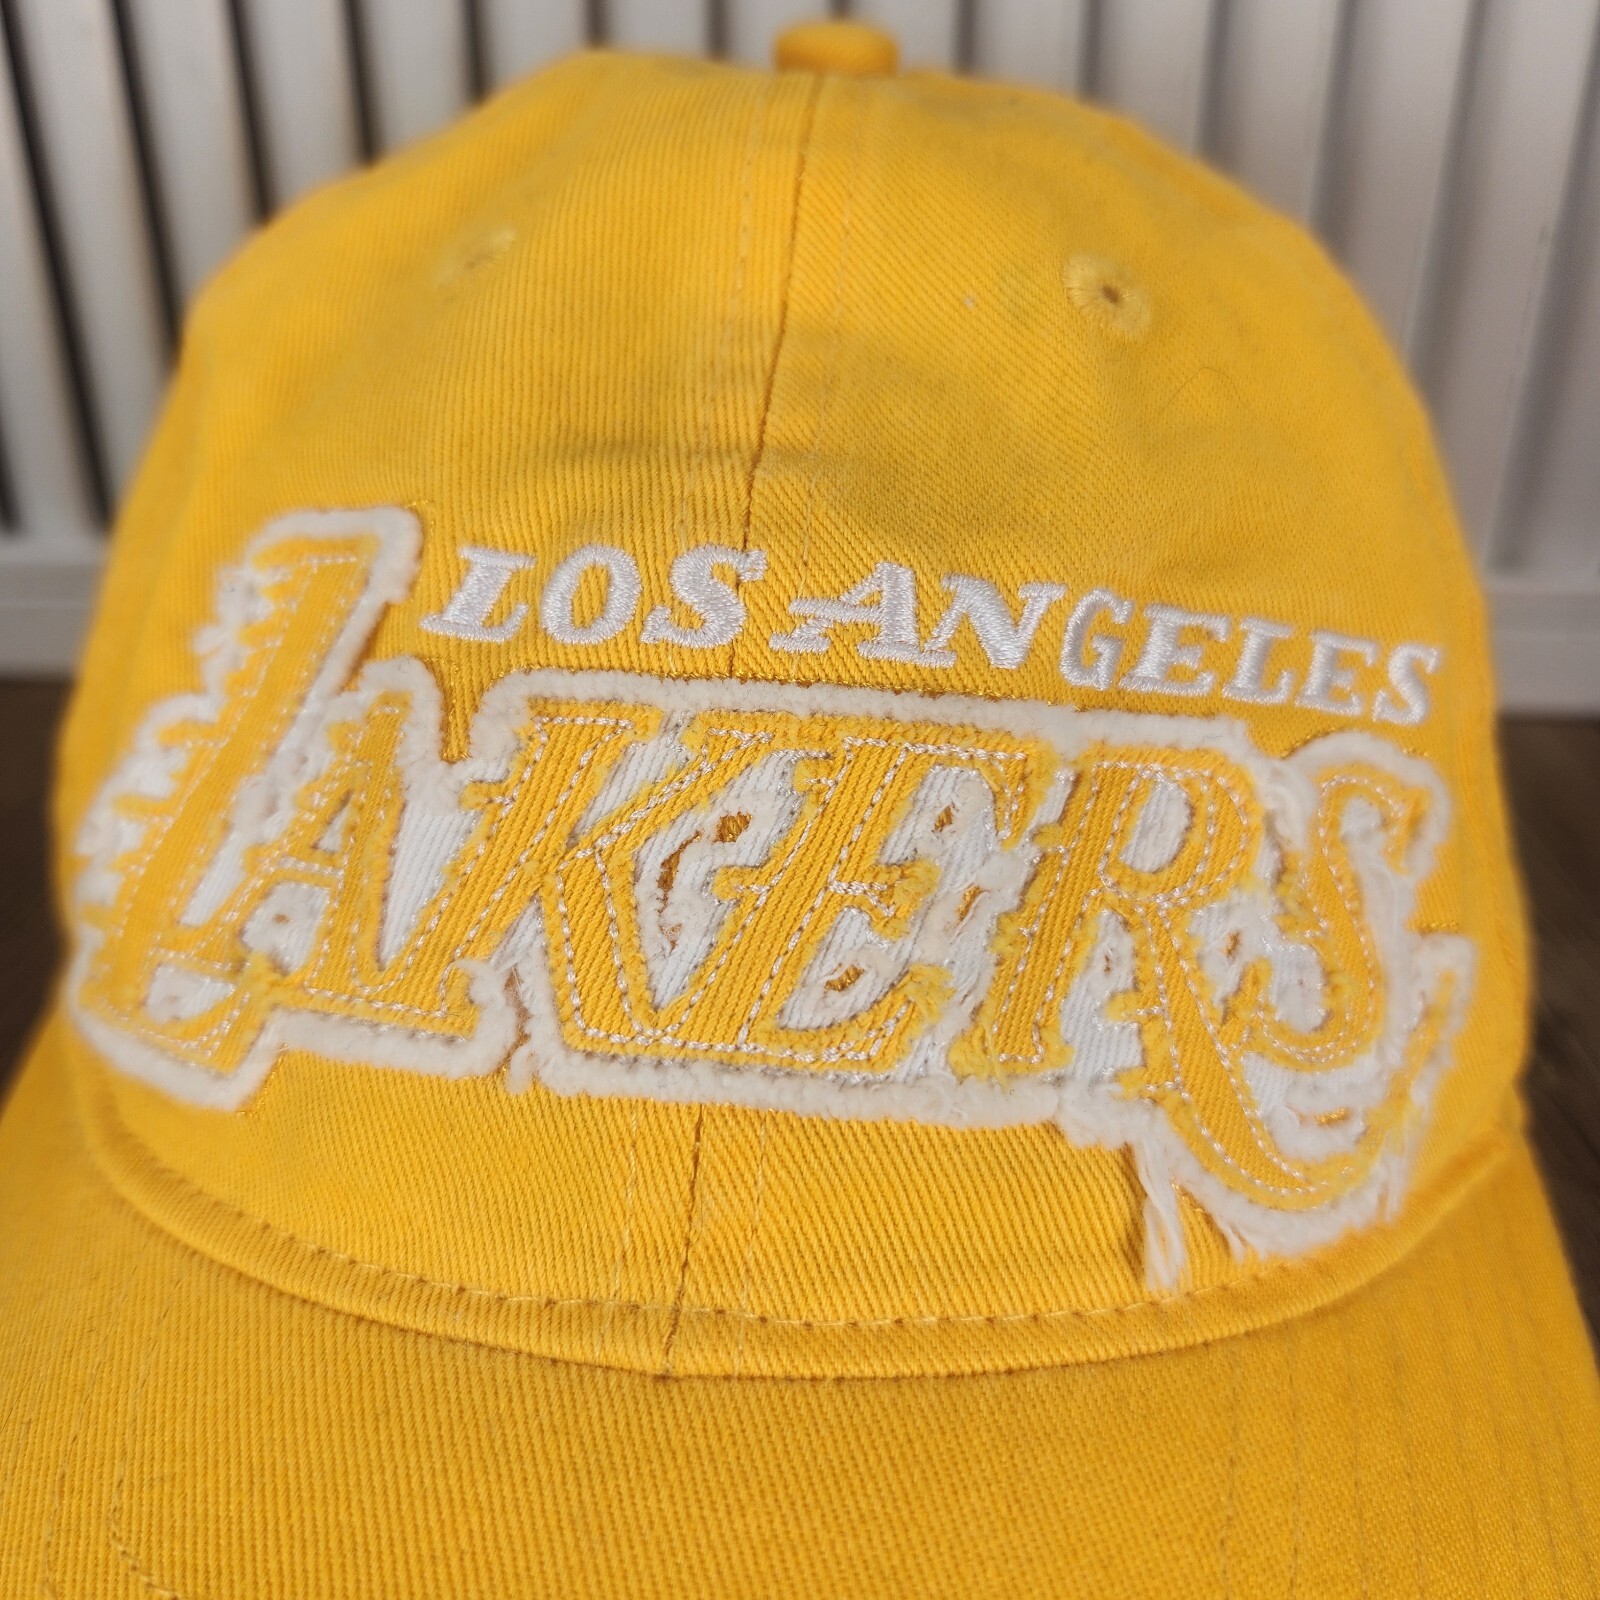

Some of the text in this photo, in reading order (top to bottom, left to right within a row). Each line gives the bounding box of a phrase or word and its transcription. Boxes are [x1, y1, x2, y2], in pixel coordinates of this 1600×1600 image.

[419, 543, 1441, 726] LOS ANGELES
[78, 520, 1440, 1220] LAKERS
